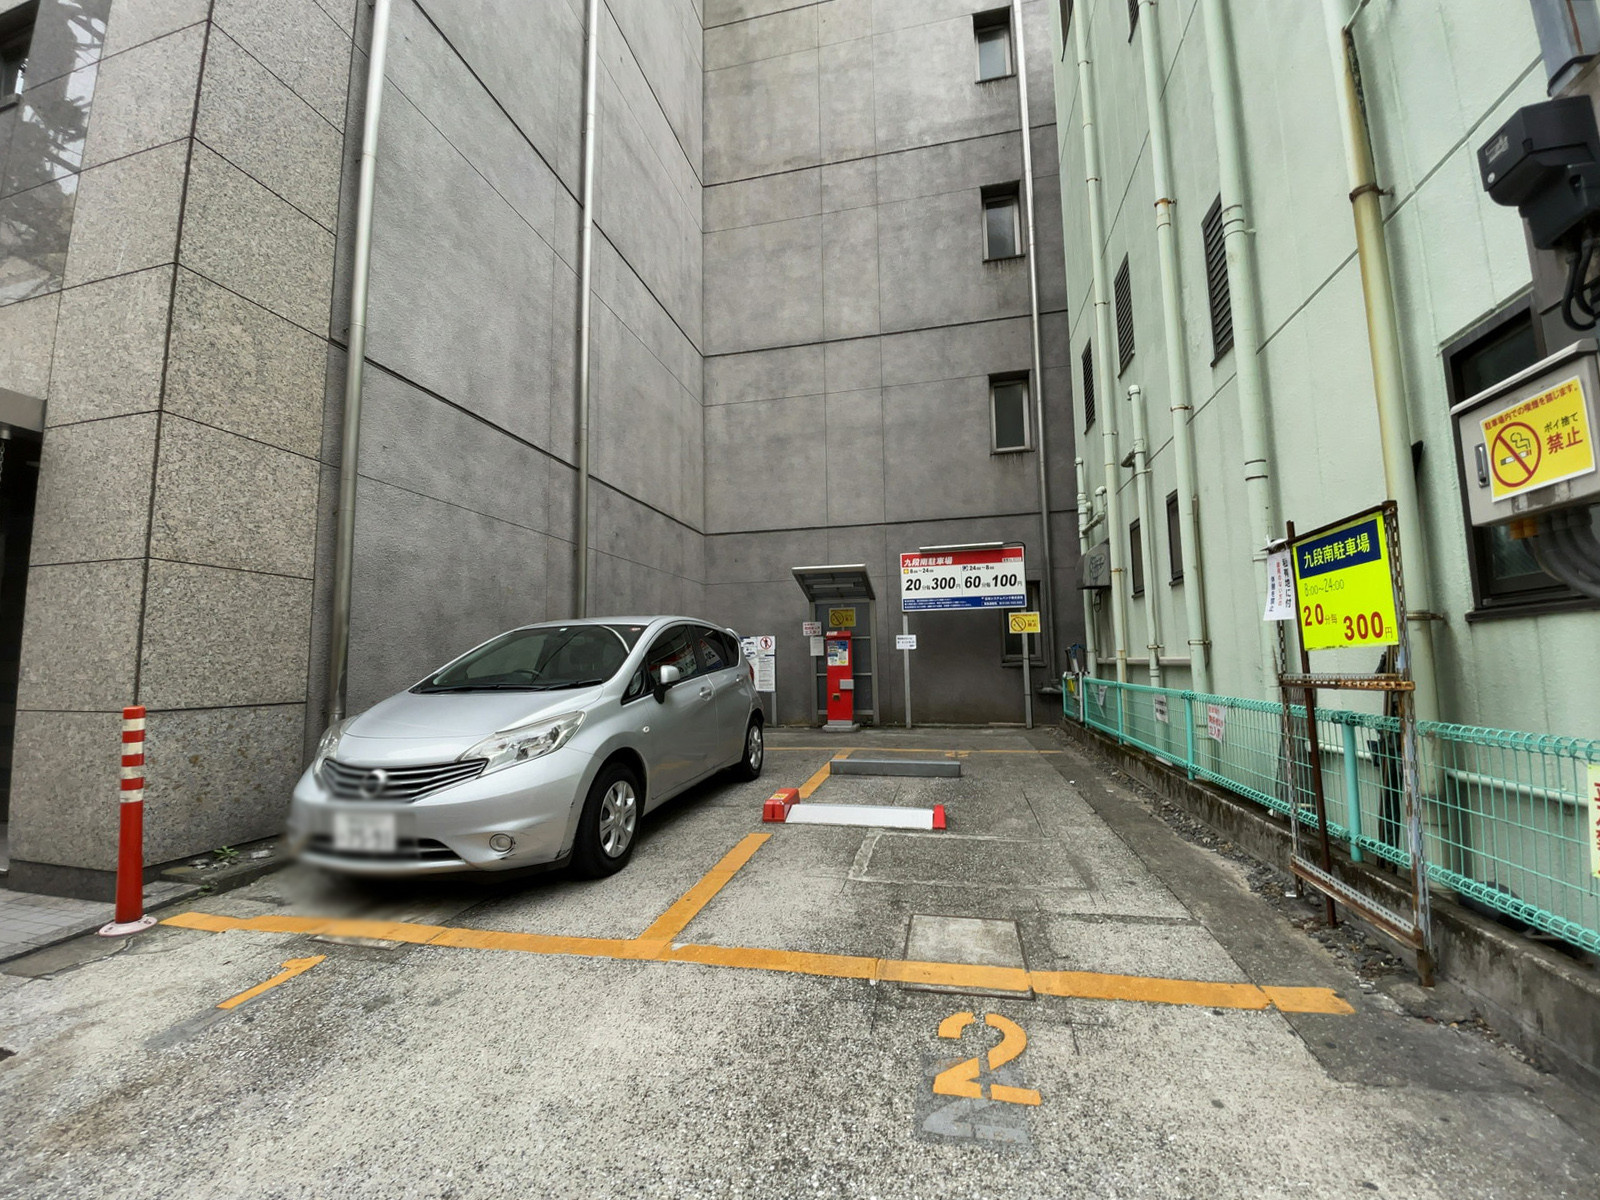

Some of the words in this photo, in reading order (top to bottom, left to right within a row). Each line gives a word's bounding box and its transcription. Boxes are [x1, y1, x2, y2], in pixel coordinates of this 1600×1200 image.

[1546, 426, 1584, 455] 禁止
[1303, 532, 1370, 569] 九段南駐車場
[932, 1011, 1042, 1106] 2
